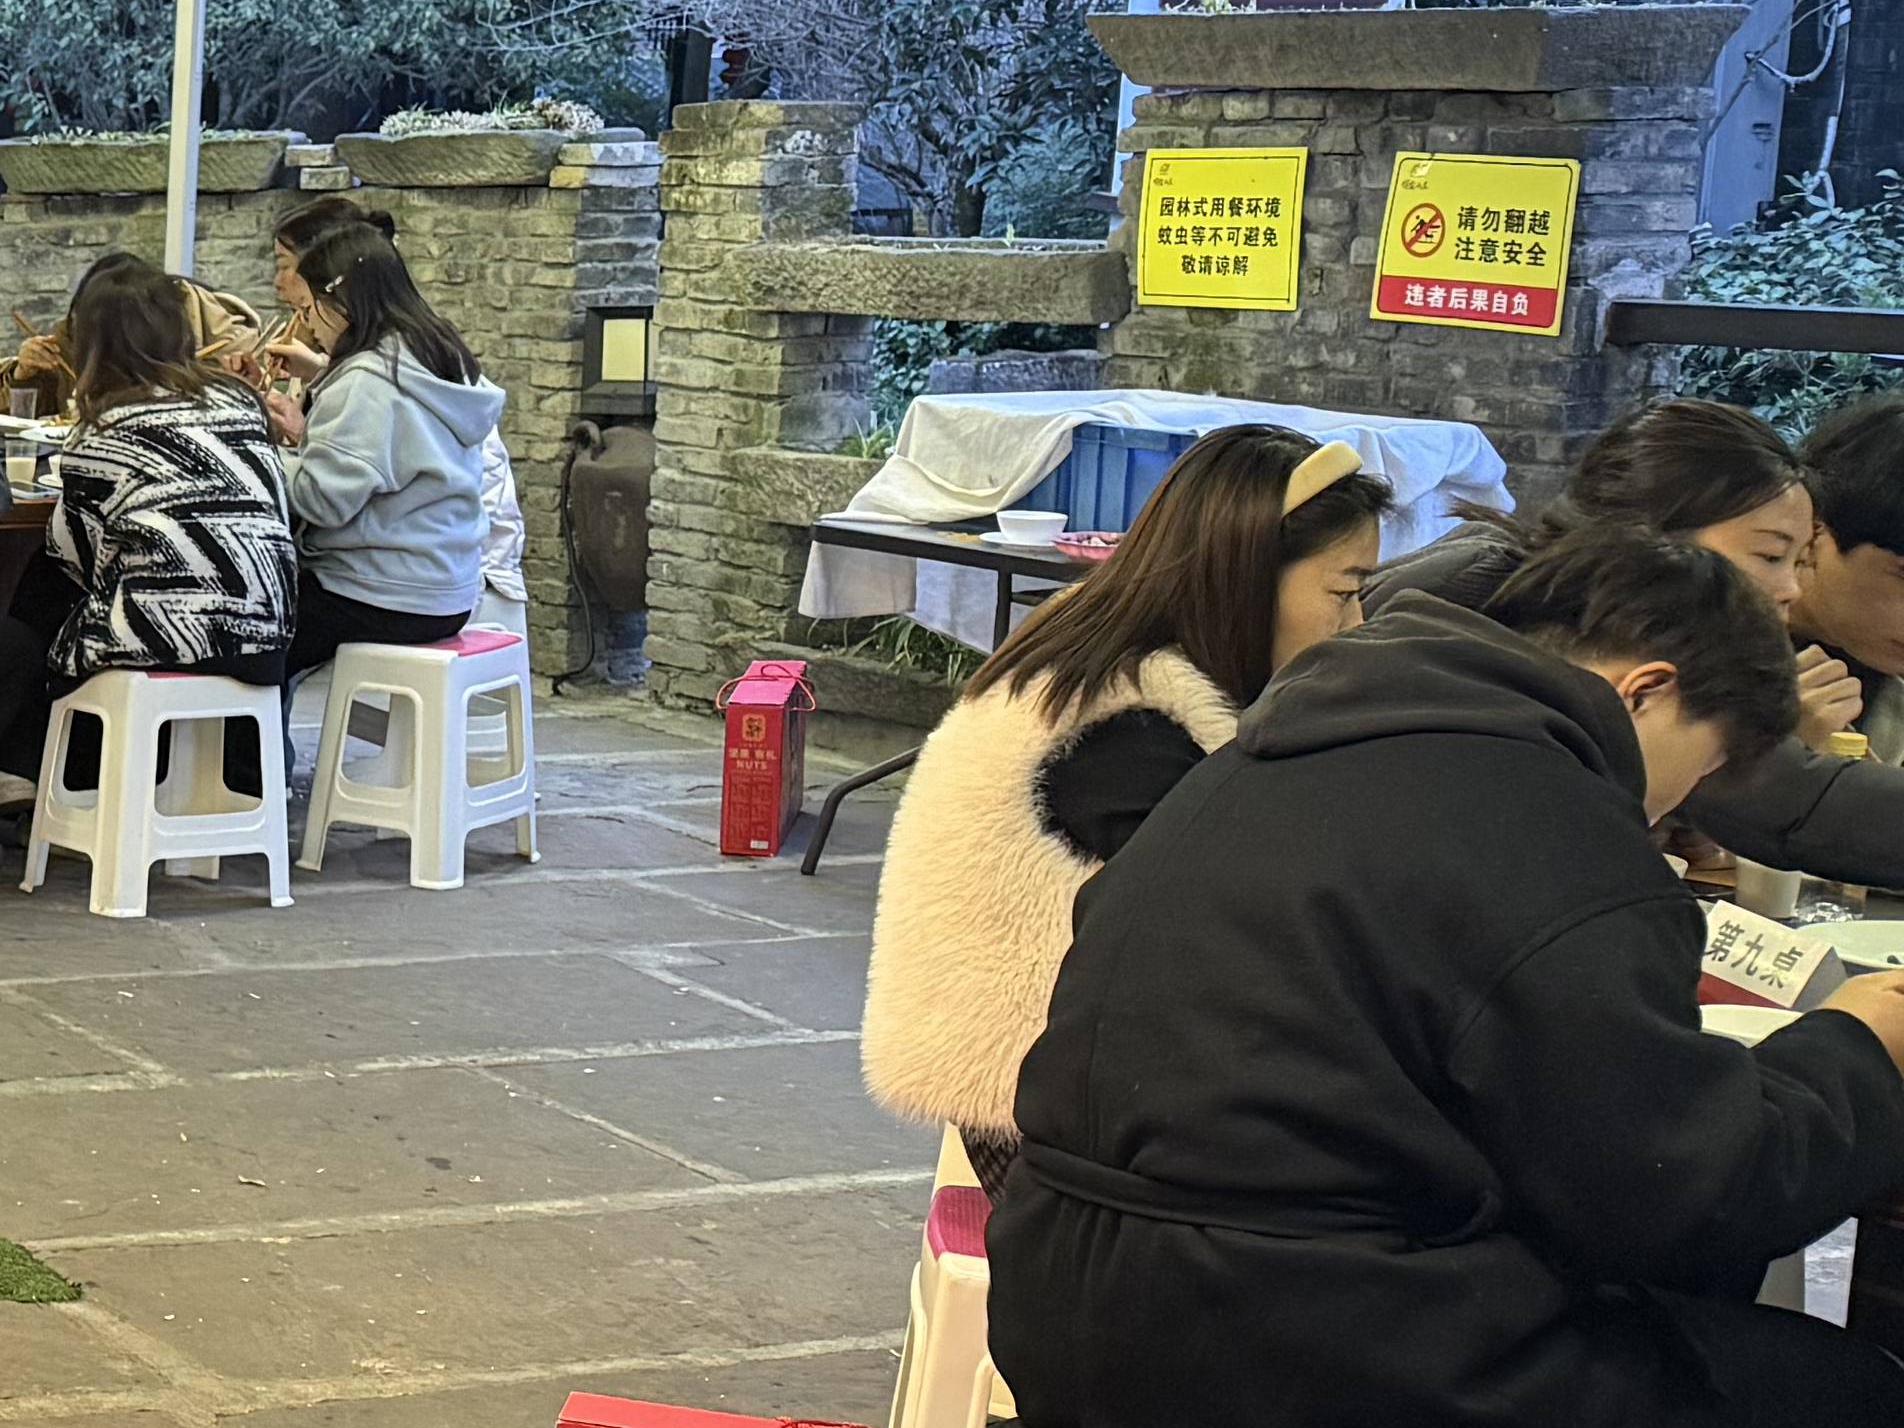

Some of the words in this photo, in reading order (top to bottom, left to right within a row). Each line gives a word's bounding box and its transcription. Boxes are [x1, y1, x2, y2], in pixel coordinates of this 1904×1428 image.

[1160, 197, 1281, 218] 园林式用餐环境
[1457, 206, 1551, 235] 请勿翻越
[1158, 226, 1279, 247] 蚊虫等不可避免
[1181, 255, 1248, 276] 敬请谅解
[1454, 237, 1547, 267] 注意安全
[1404, 283, 1529, 316] 违者后果自负
[1704, 919, 1804, 988] 第九桌
